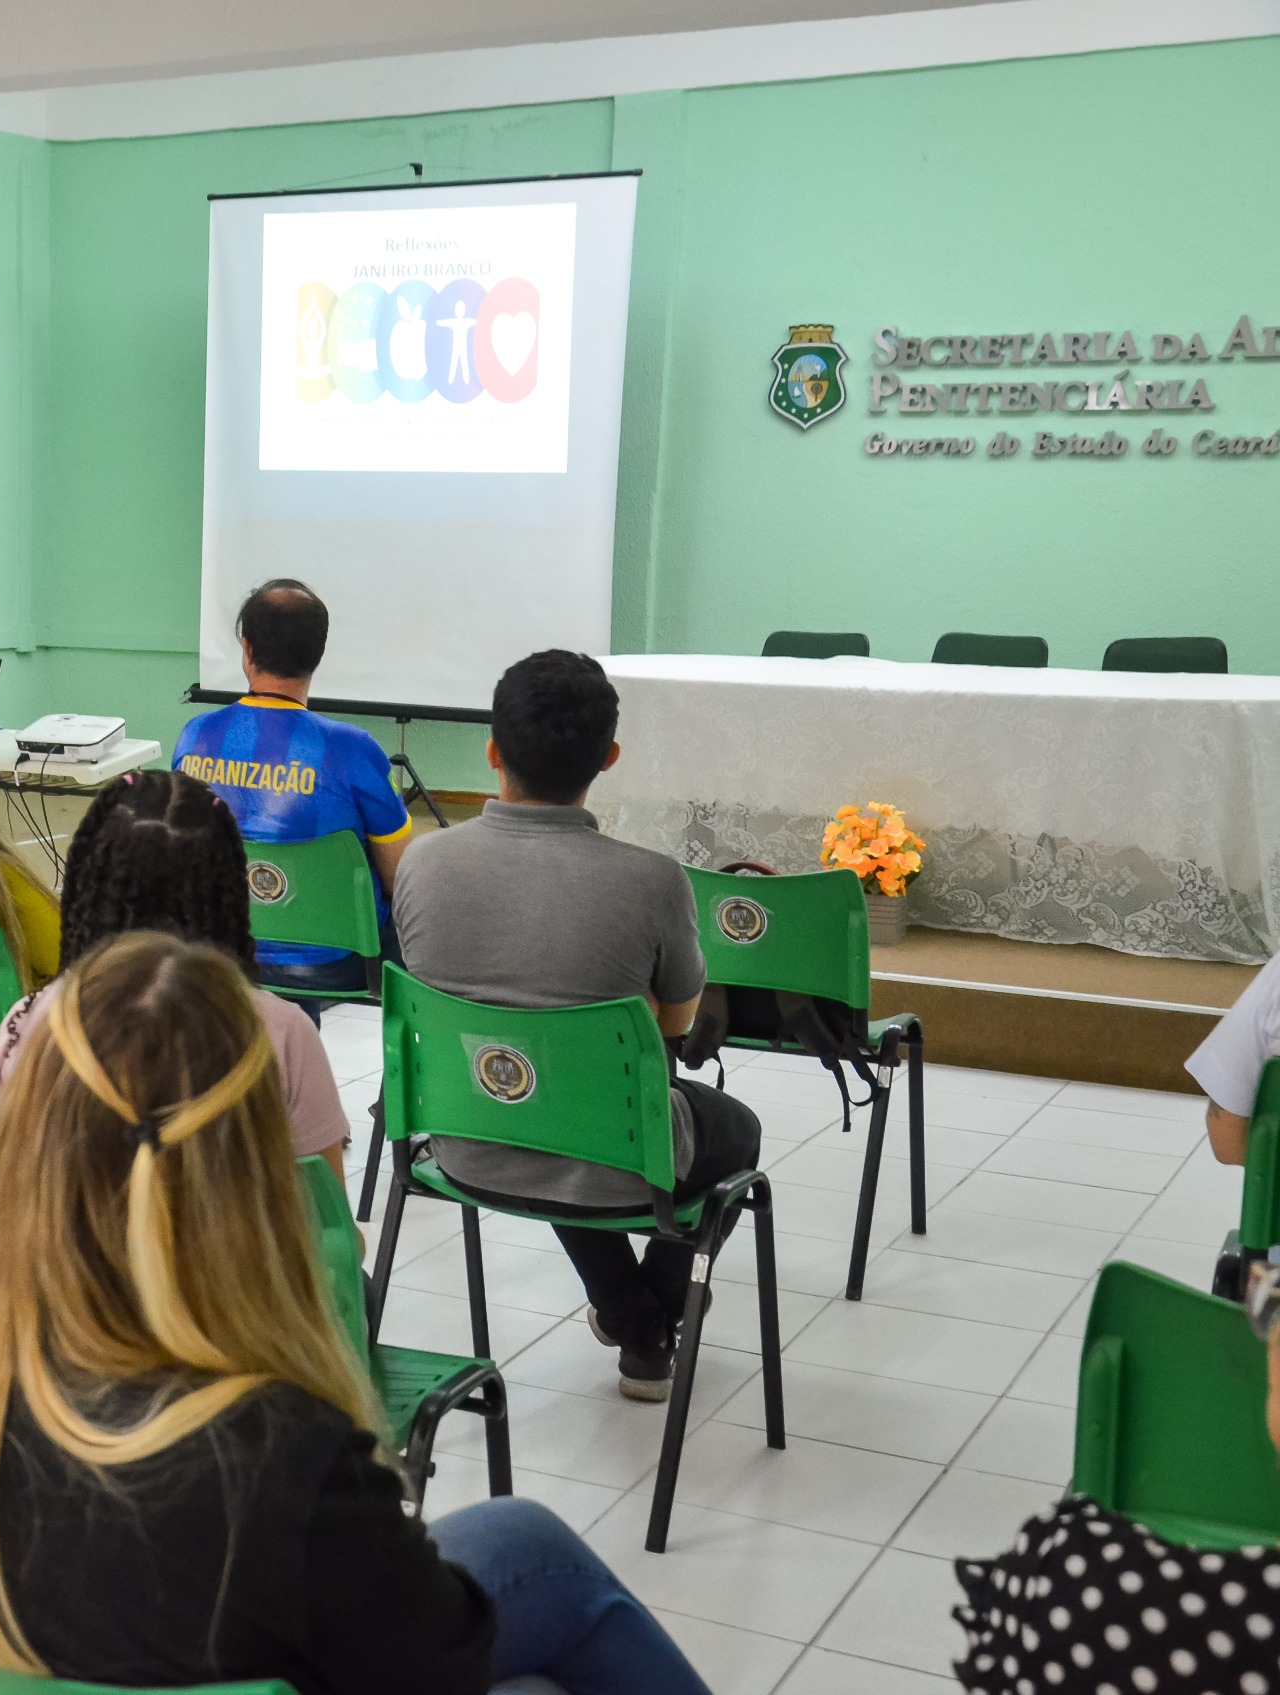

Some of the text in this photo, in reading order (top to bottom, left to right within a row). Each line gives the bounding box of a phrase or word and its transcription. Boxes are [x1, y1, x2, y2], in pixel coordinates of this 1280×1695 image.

[384, 236, 460, 253] Reflexões
[352, 261, 492, 279] JANEIRO BRANCO
[871, 325, 1143, 367] SECRETARIA
[1152, 332, 1212, 364] DA
[867, 369, 1216, 414] PENITENCIÁRIA
[864, 431, 977, 456] Governo
[986, 432, 1020, 457] do
[1032, 430, 1129, 457] Estado
[1141, 428, 1179, 455] do
[180, 754, 316, 796] ORGANIZAÇÃO
